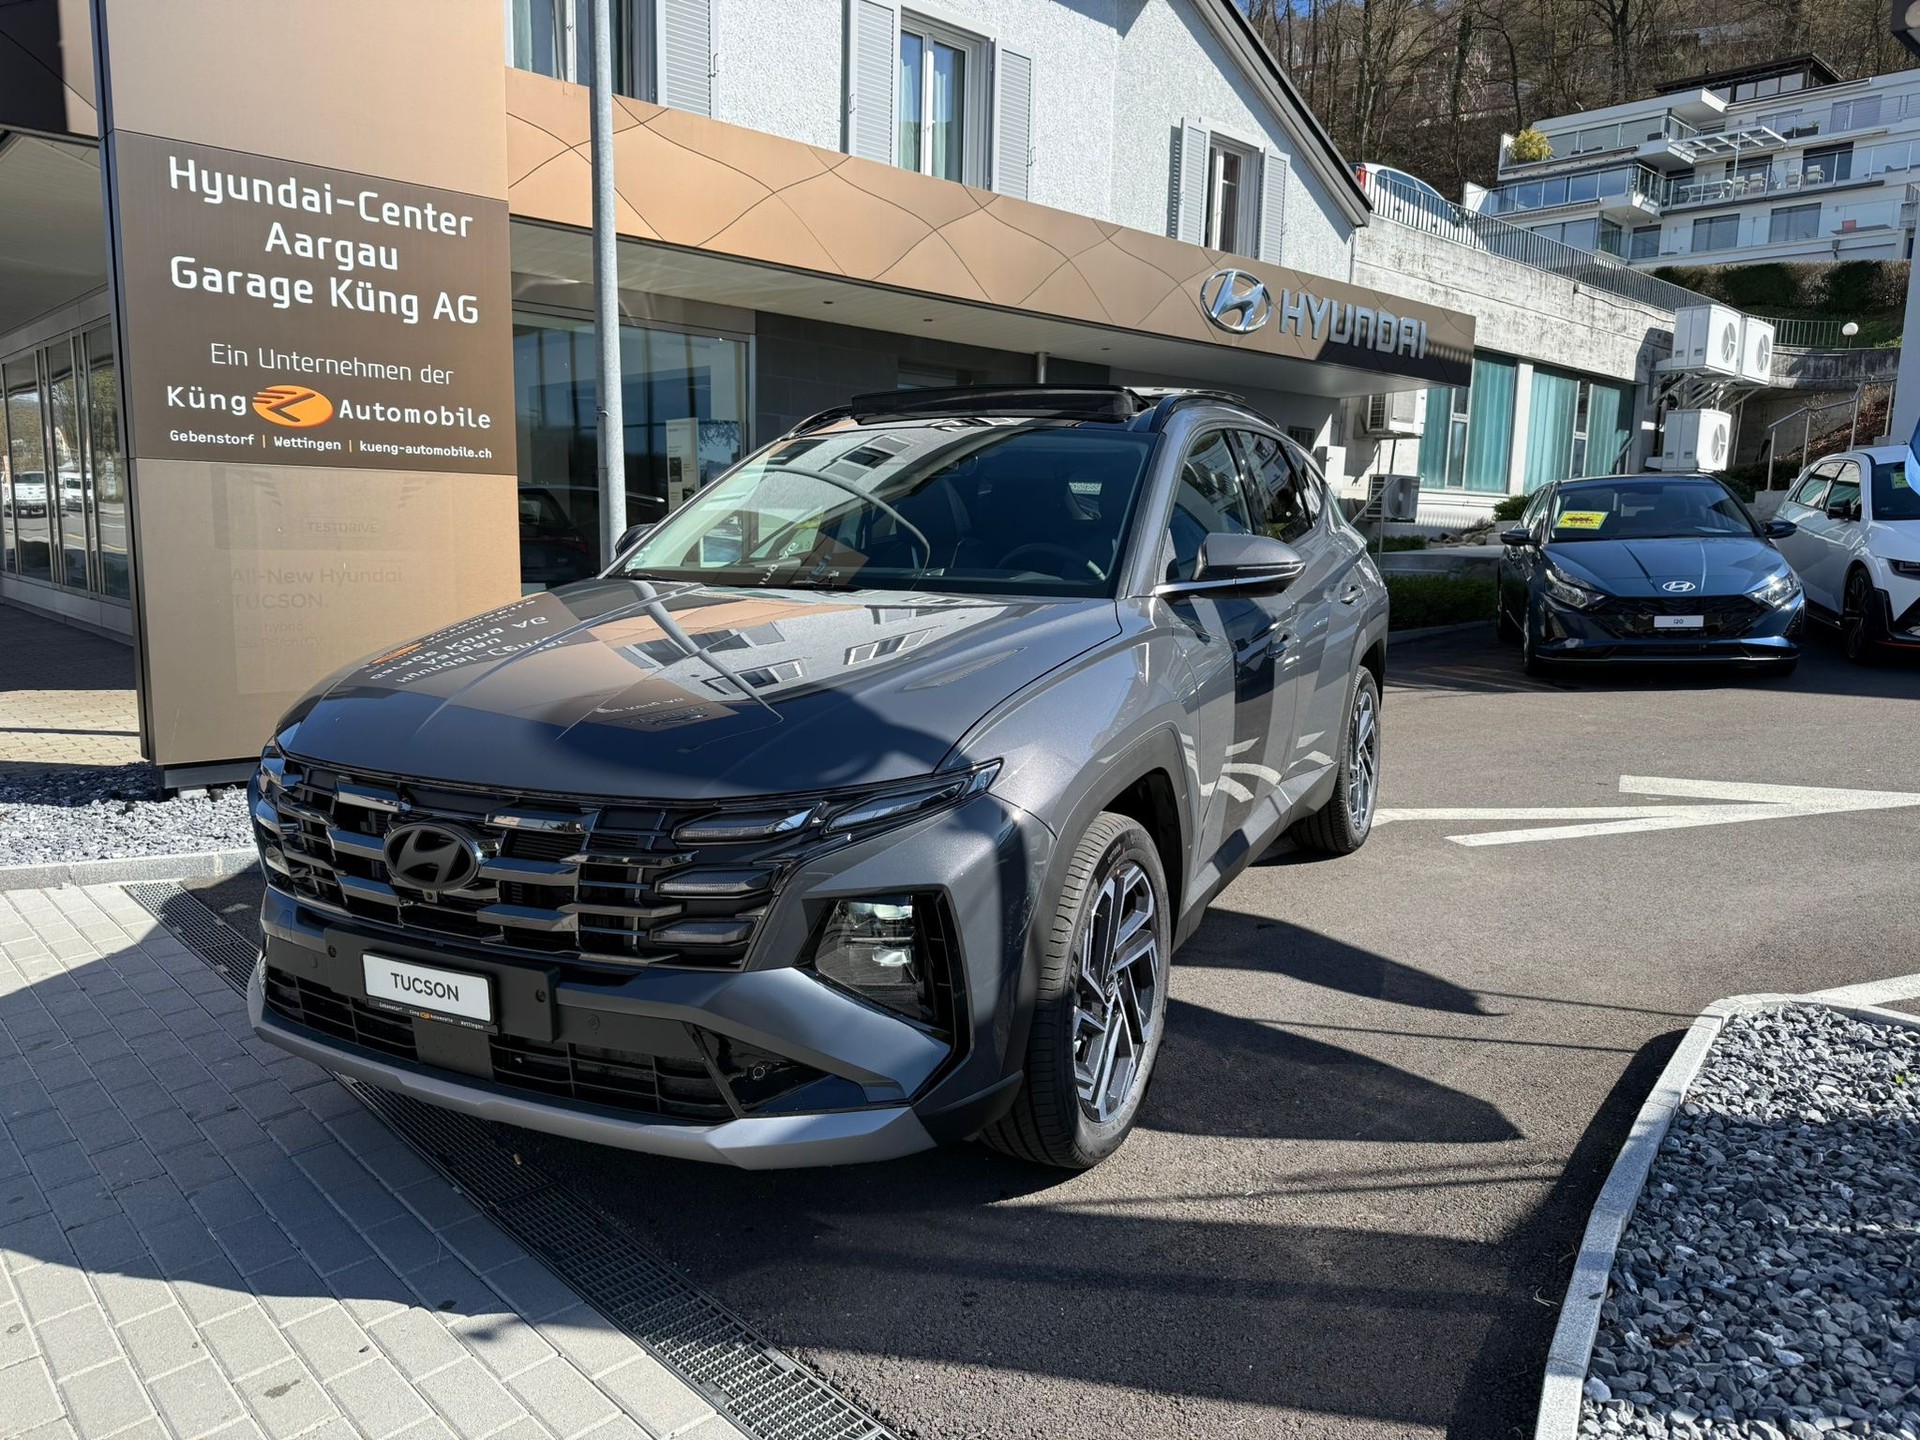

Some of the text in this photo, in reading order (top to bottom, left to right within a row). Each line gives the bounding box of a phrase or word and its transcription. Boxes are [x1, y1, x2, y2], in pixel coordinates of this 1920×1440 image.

[169, 156, 474, 238] Hyundai-Center
[265, 222, 399, 271] Aargau
[171, 256, 479, 325] Garage Küng AG
[1279, 287, 1429, 360] HYUNDAI
[210, 342, 455, 386] Ein Unternehmen der
[167, 385, 491, 429] Küng Automobile
[169, 430, 493, 459] Gebenstorf Wettingen kueng-automobile.ch
[307, 521, 379, 534] TESTDRIVE
[232, 566, 403, 587] All-New Hyundai
[390, 972, 460, 1002] TUCSON
